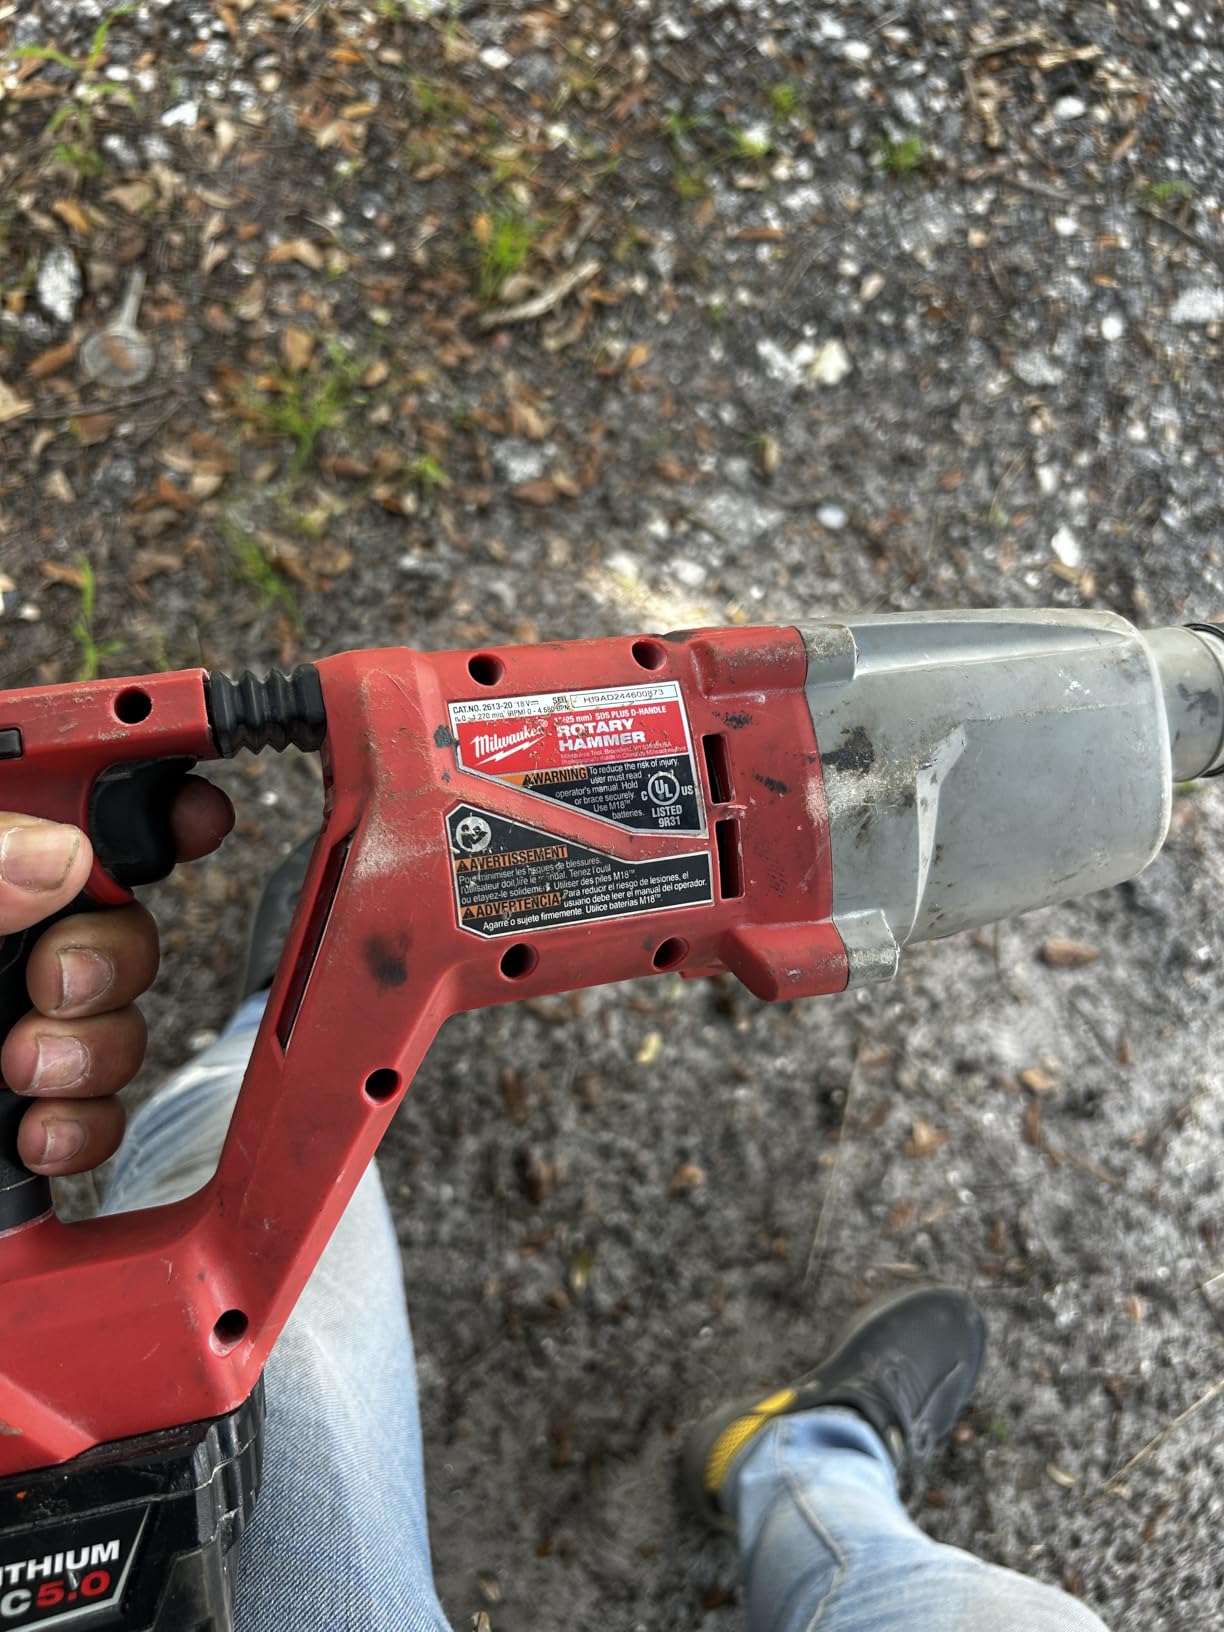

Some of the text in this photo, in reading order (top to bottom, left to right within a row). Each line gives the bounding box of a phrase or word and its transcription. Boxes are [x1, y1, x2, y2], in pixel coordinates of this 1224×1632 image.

[584, 688, 664, 703] H19AD244600873
[482, 701, 513, 711] 2613-20
[595, 712, 610, 721] SDS
[611, 710, 630, 719] PLUS
[630, 705, 667, 716] D-HANDLE
[556, 718, 634, 738] ROTARY
[559, 731, 646, 752] HAMMER
[589, 758, 680, 775] To reduce the risk of injury.
[534, 767, 587, 785] WARNING
[590, 771, 642, 785] user must read
[555, 781, 638, 799] operator's manual. Hold
[583, 795, 604, 804] brace
[605, 791, 636, 803] securely.
[681, 785, 694, 796] US
[593, 804, 608, 813] Use
[612, 809, 645, 820] batteries.
[652, 805, 683, 818] LISTED
[658, 815, 681, 828] 9R31
[470, 845, 567, 871] AVERTISSEMENT
[515, 867, 527, 876] les
[569, 868, 592, 878] Tenez
[592, 864, 612, 874] l'outil
[461, 895, 472, 905] ou
[580, 877, 594, 886] des
[595, 875, 612, 886] piles
[582, 886, 607, 895] reducir
[608, 883, 616, 891] el
[616, 880, 639, 892] riesgo
[639, 879, 649, 887] de
[682, 871, 690, 880] el
[564, 879, 707, 908] usuario debe leer el manual del operador.
[476, 893, 560, 918] ADVERTENCIA
[483, 918, 509, 932] Agarre
[510, 918, 516, 926] o
[517, 913, 540, 926] sujete
[585, 902, 608, 914] Utilice
